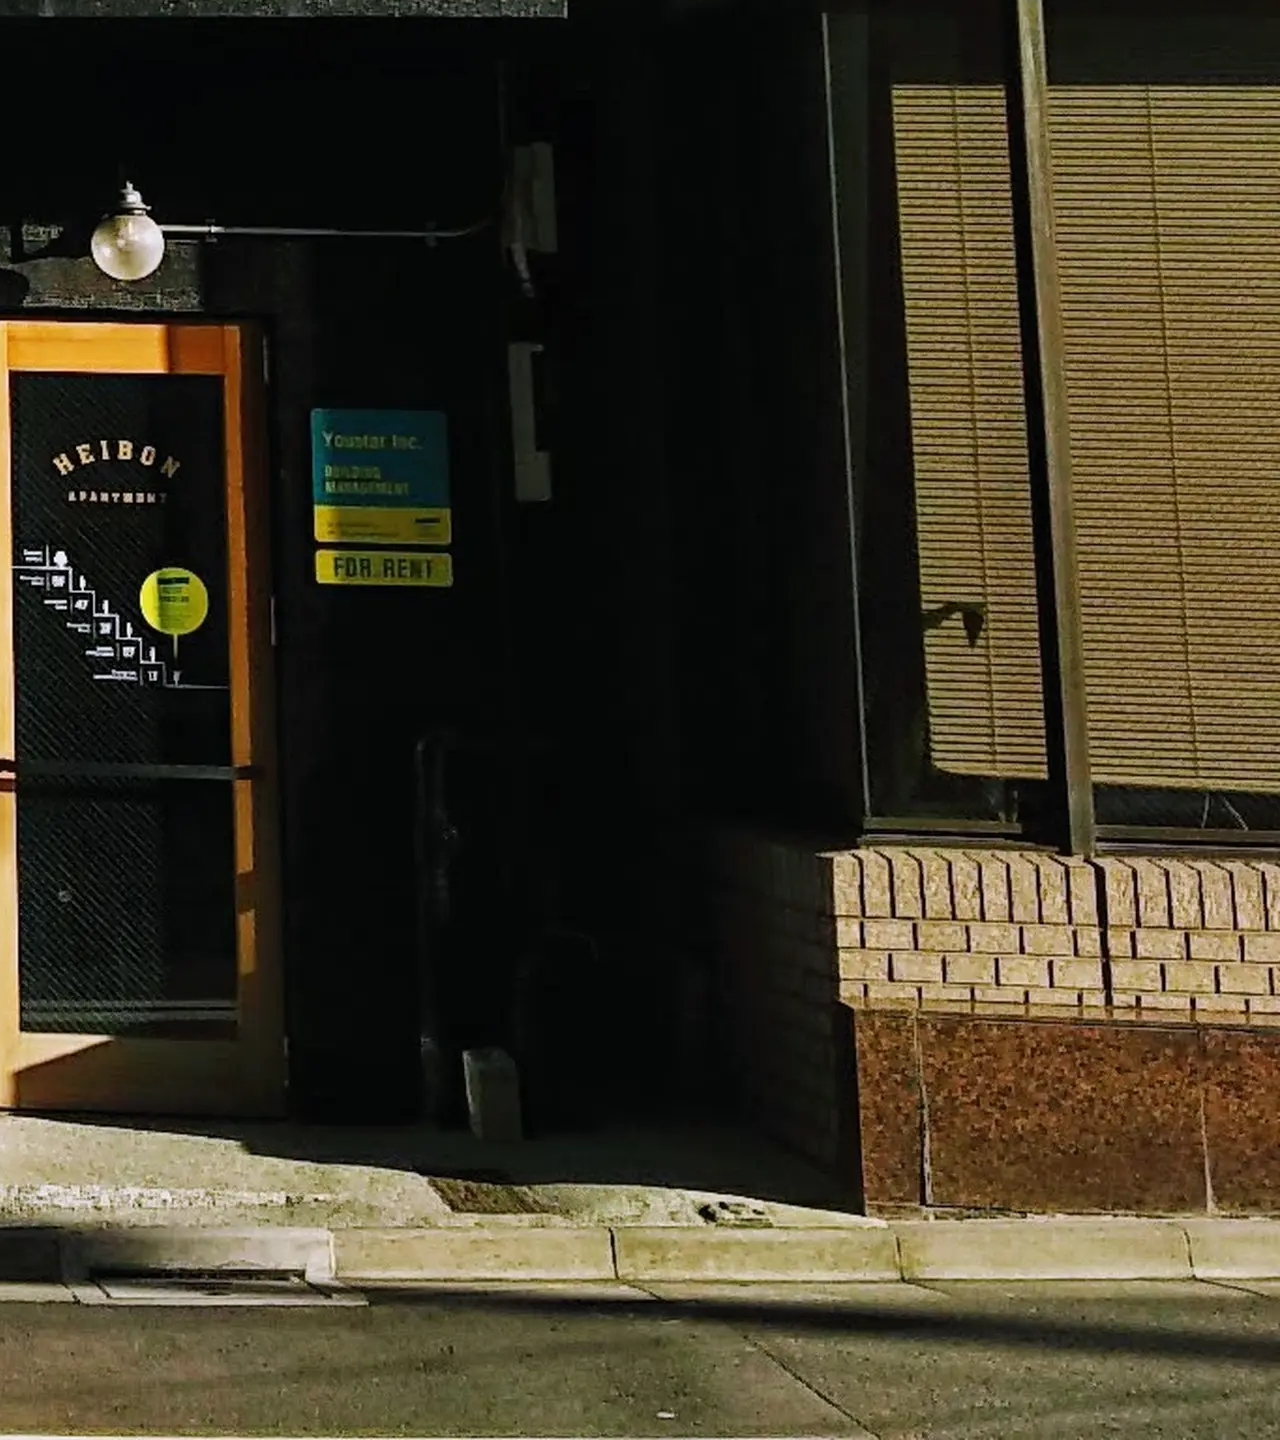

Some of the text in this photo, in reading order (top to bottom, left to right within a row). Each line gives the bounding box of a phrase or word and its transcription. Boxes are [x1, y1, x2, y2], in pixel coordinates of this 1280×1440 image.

[52, 439, 181, 479] HEIBON
[68, 491, 168, 504] APARTMENT
[334, 556, 434, 580] FOR RENT
